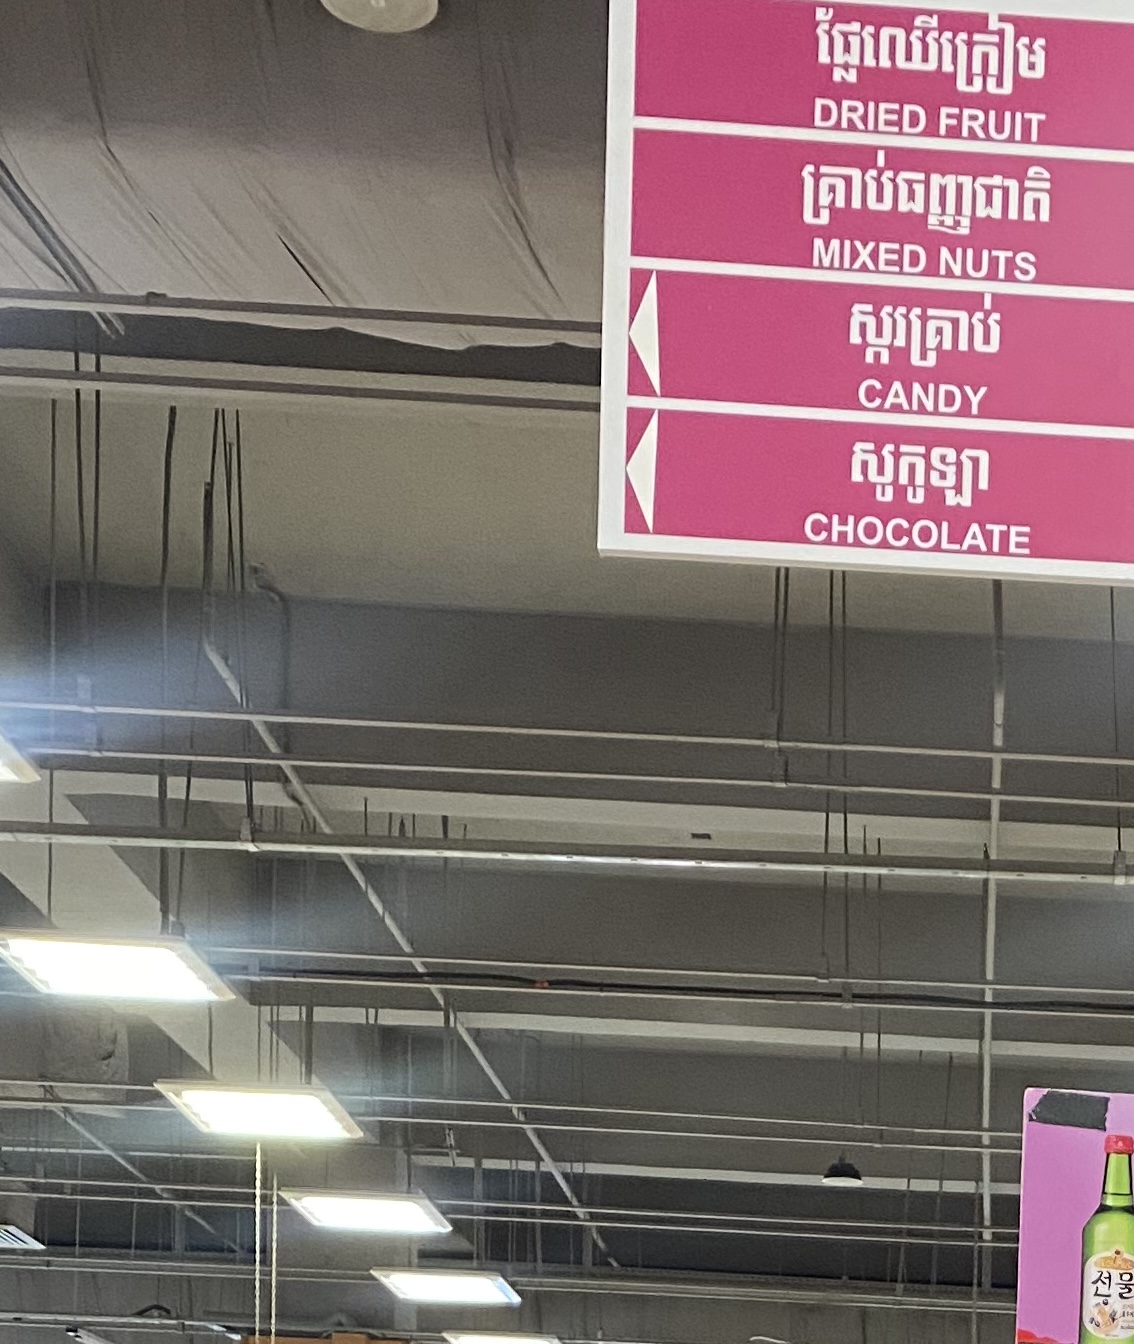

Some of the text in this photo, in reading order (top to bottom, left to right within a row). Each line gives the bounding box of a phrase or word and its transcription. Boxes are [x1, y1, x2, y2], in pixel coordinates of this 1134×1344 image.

[813, 98, 1047, 143] DRIED FRUIT
[812, 238, 1038, 282] MIXED NUTS
[858, 378, 988, 416] CANDY
[850, 441, 990, 507] សូកូឡា
[803, 512, 1032, 556] CHOCOLATE
